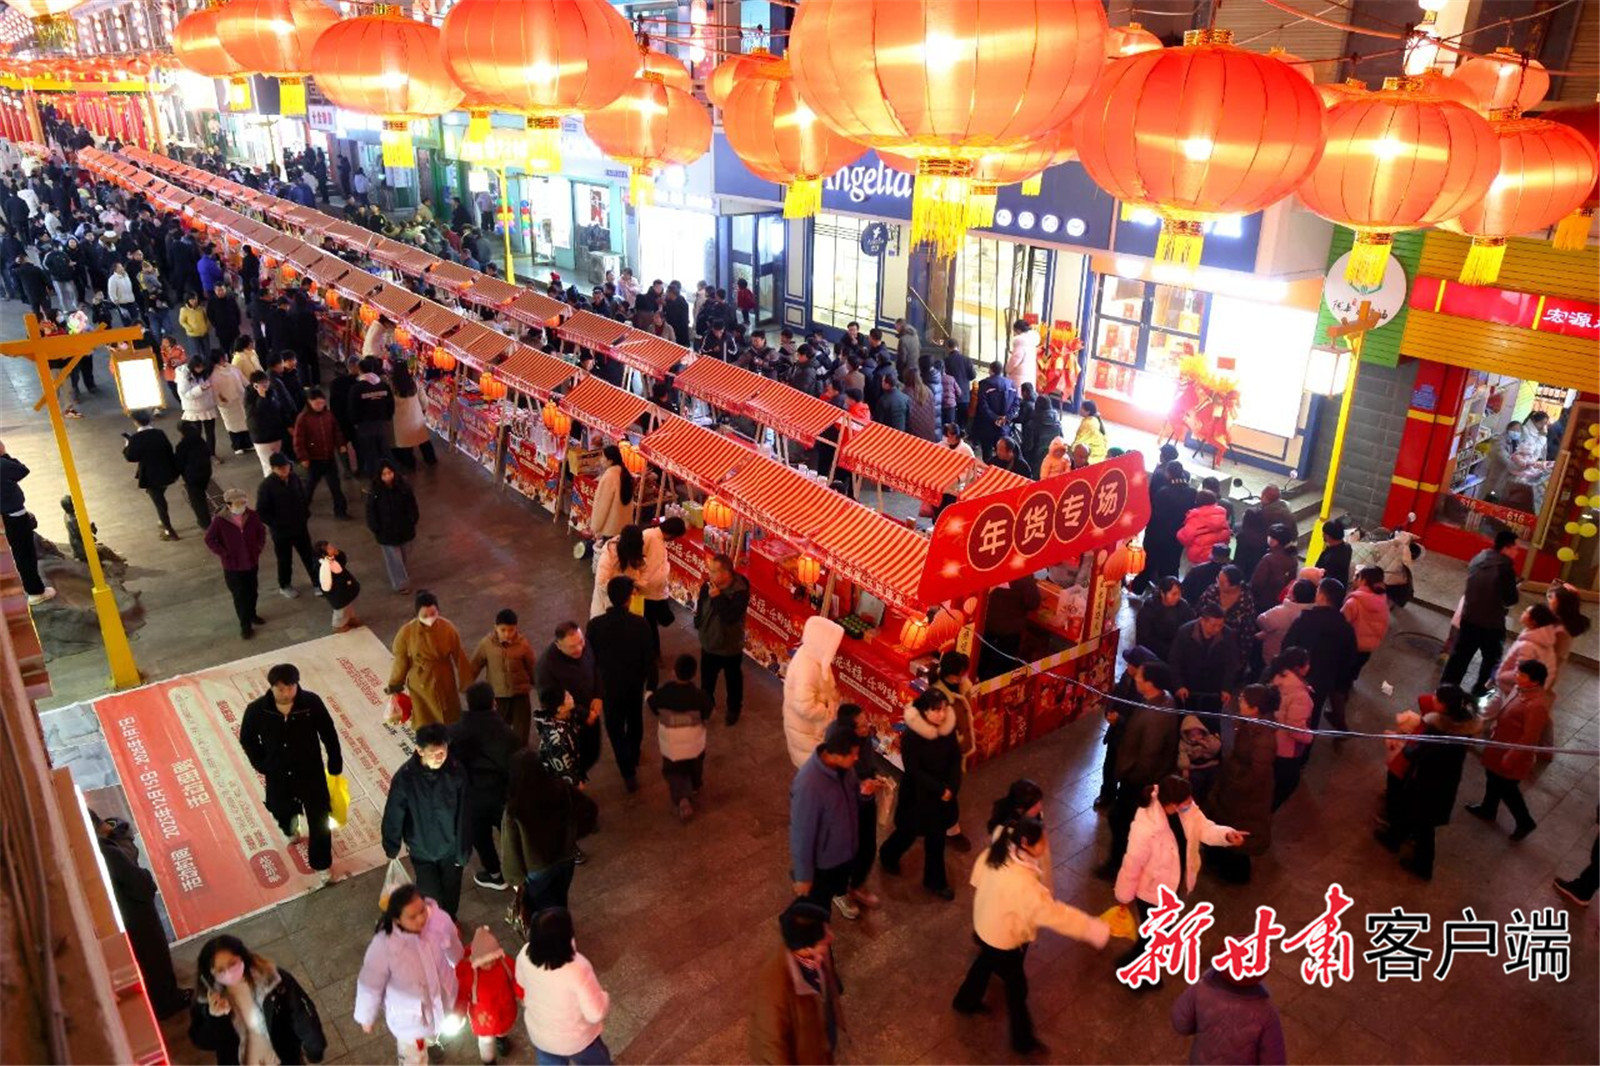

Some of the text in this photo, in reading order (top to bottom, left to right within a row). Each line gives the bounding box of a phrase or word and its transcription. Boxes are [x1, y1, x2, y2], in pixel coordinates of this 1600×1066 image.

[977, 481, 1120, 555] 年货专场
[1506, 510, 1525, 523] 616
[170, 847, 204, 892] 活动时间
